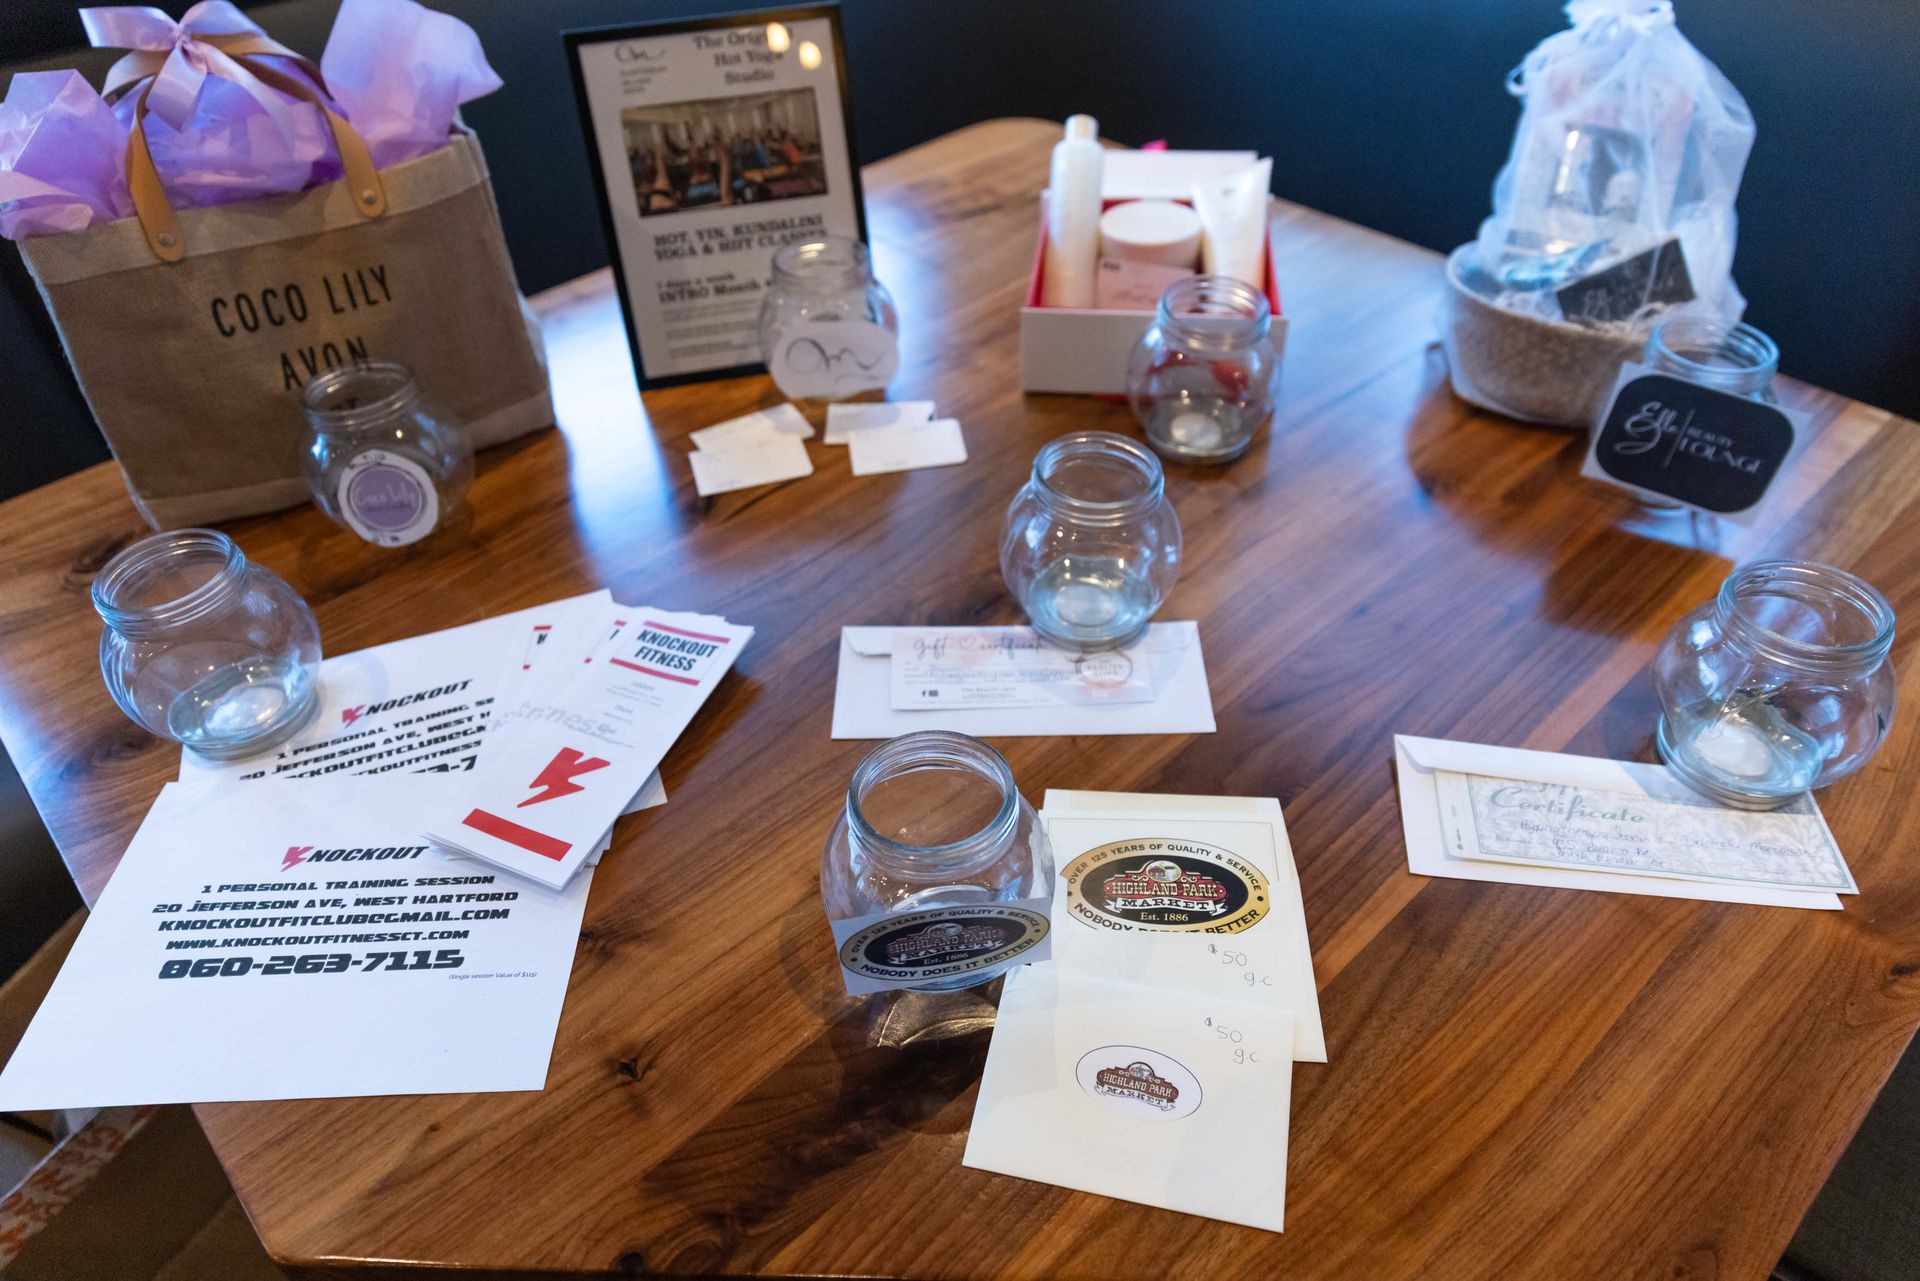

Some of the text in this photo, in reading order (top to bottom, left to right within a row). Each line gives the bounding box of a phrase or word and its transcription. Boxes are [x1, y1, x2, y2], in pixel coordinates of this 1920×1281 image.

[210, 264, 393, 338] COCO LILY
[280, 335, 371, 392] AVON
[637, 628, 720, 658] KNOCKOUT
[634, 646, 697, 672] FITNESS
[342, 678, 474, 728] KNOCKOUT
[292, 726, 388, 756] PERSONAL
[393, 704, 470, 729] TRAINING
[271, 742, 376, 775] JEFFERSON
[382, 731, 422, 745] AVE,
[427, 715, 474, 733] WEST
[1489, 785, 1645, 824] Certificate
[281, 845, 430, 873] KNOCKOUT
[1069, 843, 1262, 892] OVER 125 YEARS OF QUALITY & SERVICE
[201, 875, 496, 894] 1 PERSONAL TRAINING SESSION
[1111, 882, 1219, 898] HIGHLAND PARK
[151, 891, 520, 913] 20 JEFFERSON AVE, WEST HARTFORD
[929, 911, 945, 919] OF
[948, 909, 994, 917] QUALITY
[1121, 898, 1211, 911] MARKET
[157, 908, 512, 932] KNOCKOUTFITCLUB@GMAIL.COM
[1140, 912, 1190, 922] Est. 1886
[165, 929, 471, 950] WWW.KNOCKOUTFITNESSCT.COM
[157, 948, 466, 980] 860-263-7115
[860, 938, 1035, 978] NOBODY DOES IT BETTER
[471, 972, 495, 980] session
[1103, 1072, 1173, 1098] HIGHLAND PARK
[1107, 1086, 1164, 1105] MARKET
